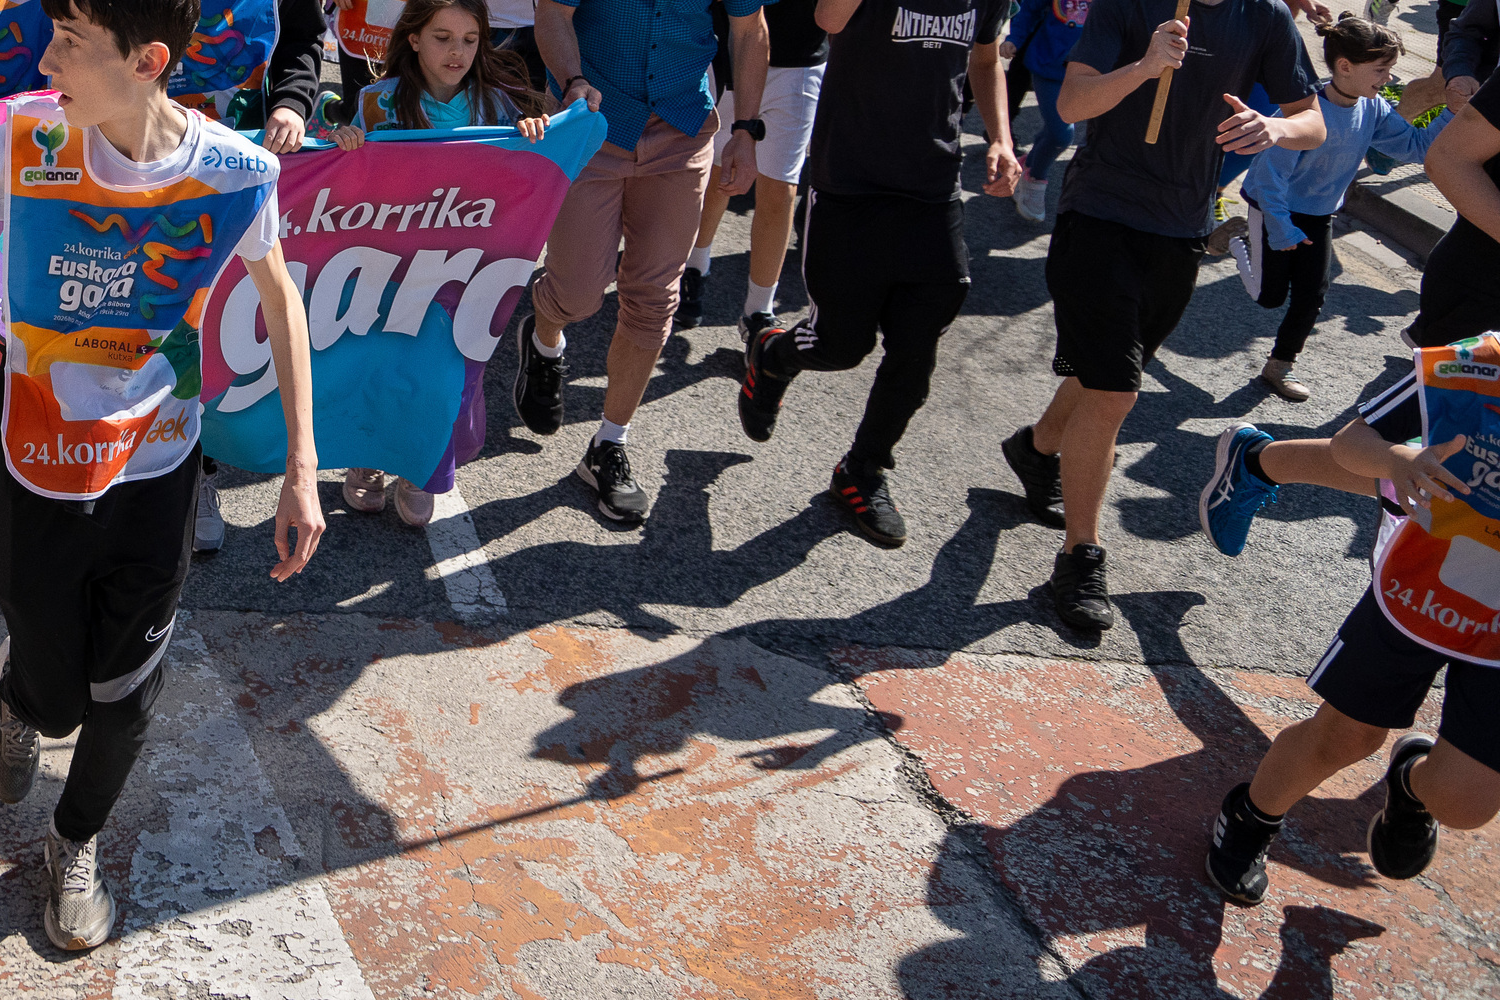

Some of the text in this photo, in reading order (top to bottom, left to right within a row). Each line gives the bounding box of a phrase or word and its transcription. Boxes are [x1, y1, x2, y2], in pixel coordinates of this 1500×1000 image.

[891, 6, 977, 42] ANTIFAXISTA
[922, 41, 943, 49] BETI
[225, 154, 268, 174] eitb
[24, 169, 80, 183] goiener
[278, 187, 496, 239] 4.korrika
[63, 242, 122, 261] 24.korrika
[48, 255, 137, 284] Euskara
[59, 277, 135, 312] gara
[74, 337, 133, 353] LABORAL
[107, 351, 133, 362] kutxa
[1439, 362, 1498, 378] goiener
[21, 408, 188, 466] 24.korrika aek
